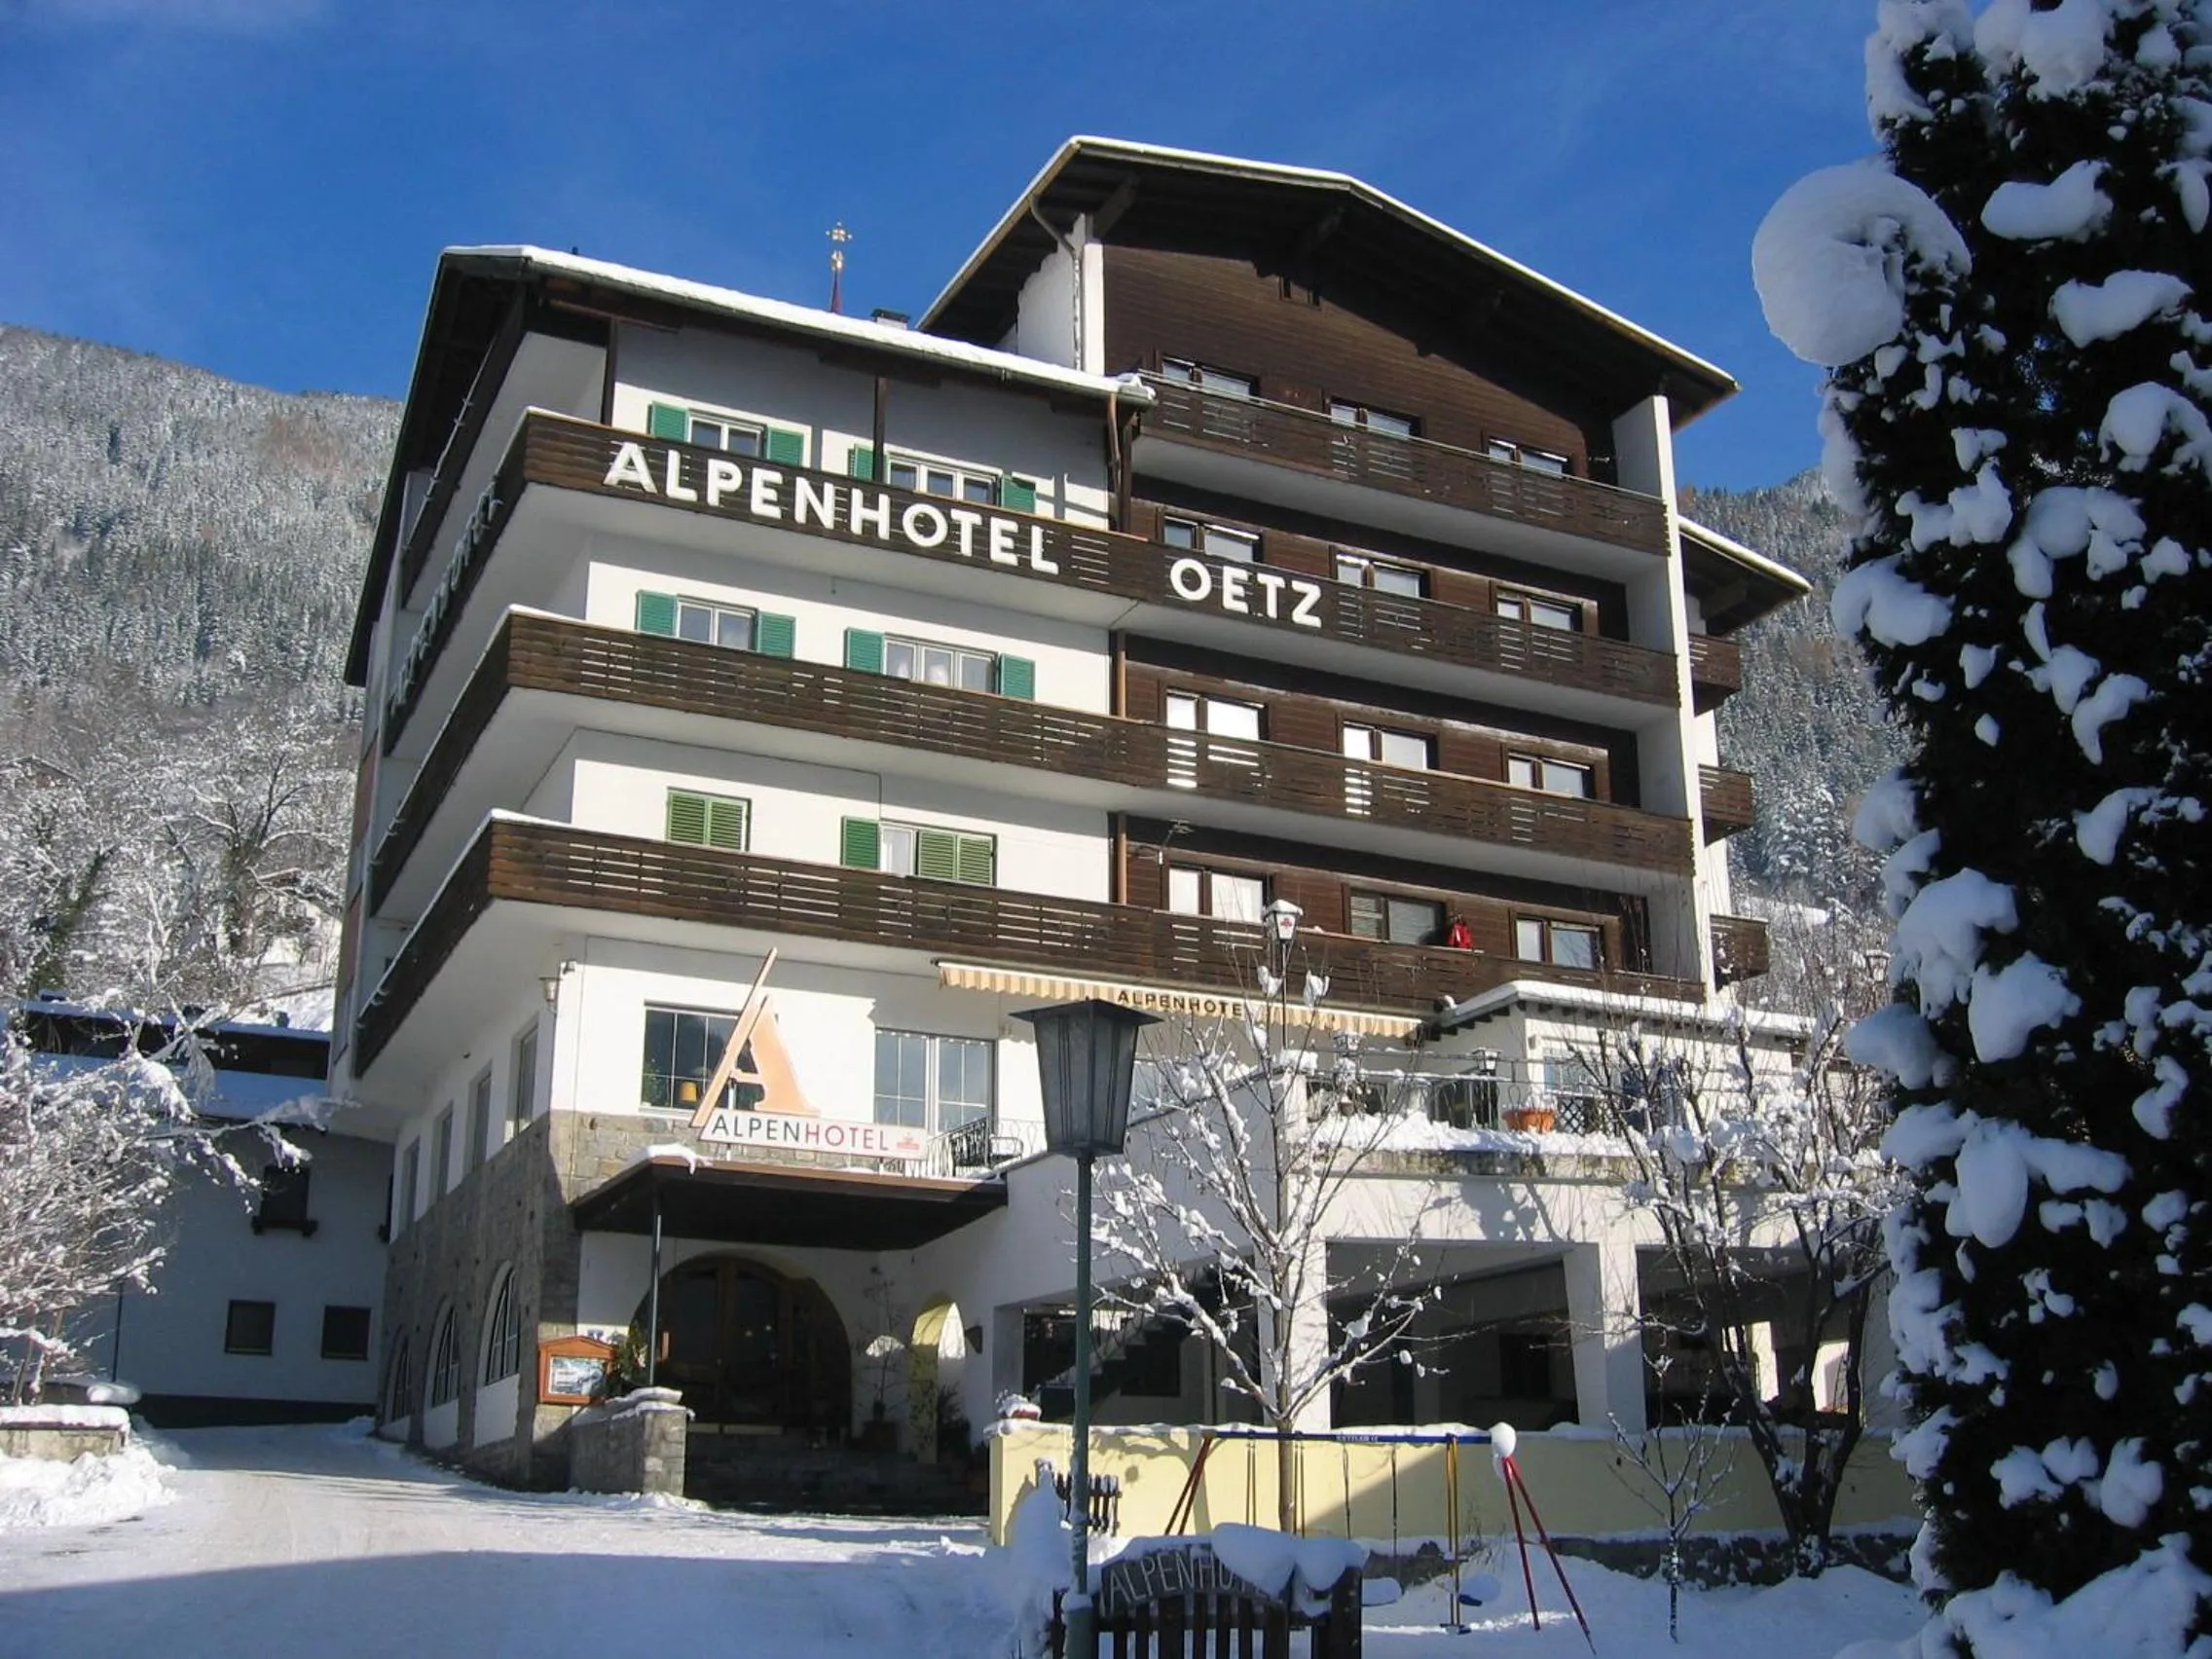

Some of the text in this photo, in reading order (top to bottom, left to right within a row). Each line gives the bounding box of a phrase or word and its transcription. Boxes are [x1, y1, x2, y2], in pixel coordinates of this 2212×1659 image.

[603, 441, 1322, 628] ALPENHOTEL OETZ
[1118, 990, 1243, 1017] ALPENHOTE
[712, 1114, 889, 1152] ALPENHOTEL
[1109, 1551, 1268, 1614] ALPENHO
